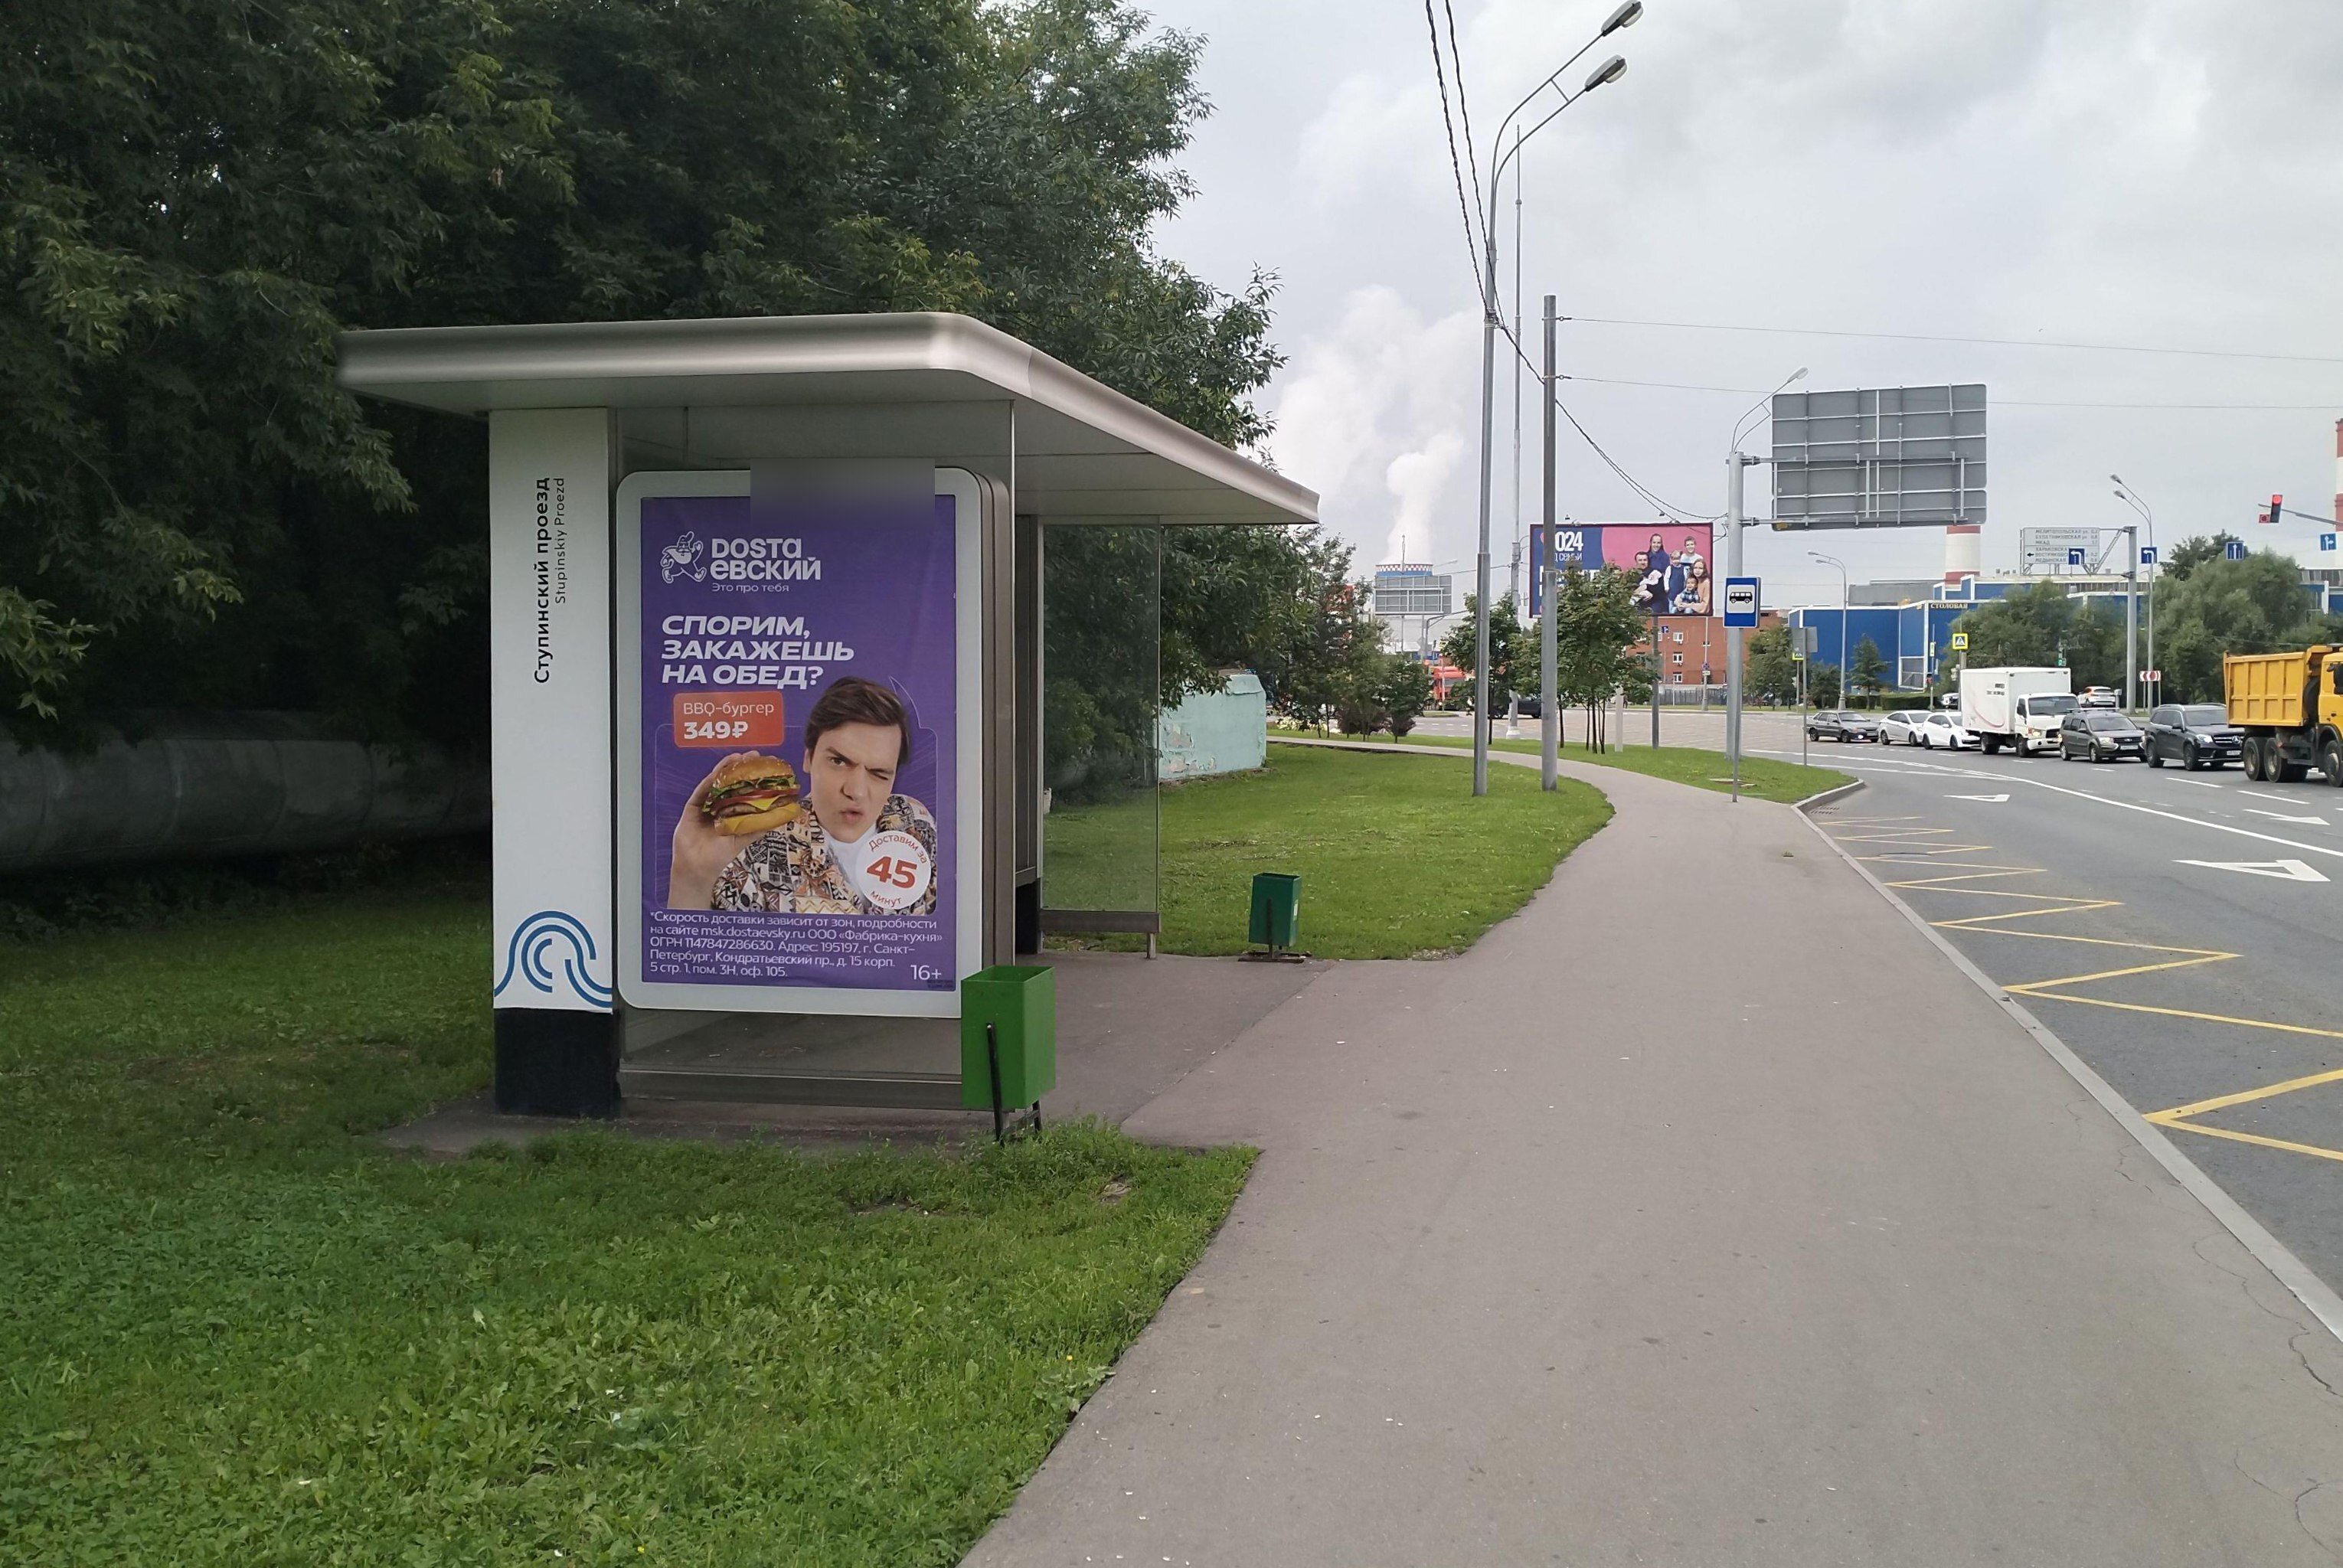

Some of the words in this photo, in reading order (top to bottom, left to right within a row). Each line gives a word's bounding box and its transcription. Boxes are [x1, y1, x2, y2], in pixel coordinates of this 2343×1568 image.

[554, 478, 565, 525] Proezd
[536, 477, 552, 554] проезд
[1554, 531, 1584, 552] 024
[554, 529, 567, 604] Stupinskiy
[711, 583, 734, 592] Это
[736, 585, 759, 593] про
[763, 583, 789, 592] тебя
[534, 560, 553, 684] Ступинский
[662, 615, 810, 639] СПОРИМ,
[662, 640, 855, 662] ЗАКАЖЕШЬ
[662, 665, 707, 684] НА
[712, 665, 824, 690] ОБЕД?
[684, 721, 748, 740] 349₽
[868, 835, 919, 852] Доставим
[917, 851, 927, 864] за
[866, 856, 917, 889] 45
[870, 890, 902, 907] минут
[711, 914, 764, 925] доставки
[766, 916, 813, 926] зависит
[815, 918, 828, 926] от
[832, 919, 855, 929] зон,
[857, 918, 937, 930] подробности
[665, 925, 698, 936] сайте
[701, 926, 806, 941] msk.dostaevsky.ru
[808, 929, 837, 939] ООО
[650, 936, 682, 948] ОГРН
[874, 943, 915, 955] Санкт-
[651, 962, 658, 972] 5
[659, 963, 681, 975] стр.
[693, 965, 717, 975] пом.
[740, 965, 763, 978] оф.
[766, 965, 788, 977] 105.
[715, 952, 812, 965] Кондратьевский
[851, 956, 862, 966] 15
[864, 958, 895, 969] корп.
[910, 965, 942, 981] 16+
